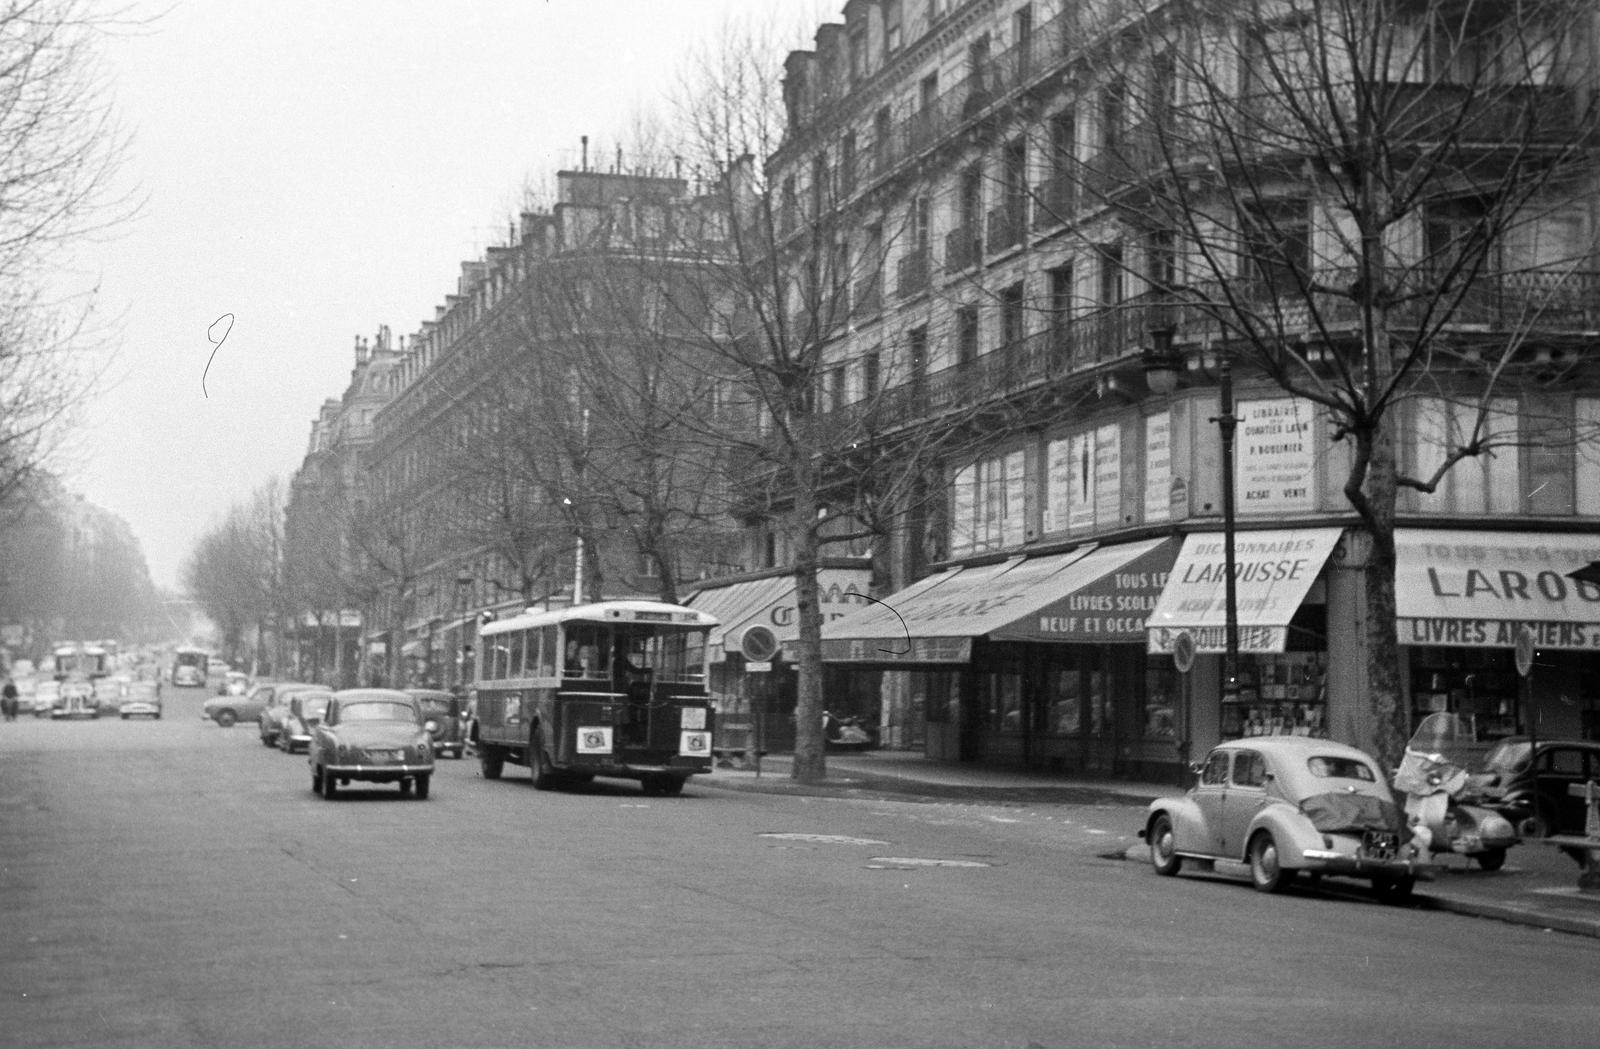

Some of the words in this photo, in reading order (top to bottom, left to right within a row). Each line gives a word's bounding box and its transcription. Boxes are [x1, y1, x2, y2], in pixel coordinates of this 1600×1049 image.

[1253, 407, 1299, 419] LIBRAIRIE
[1245, 425, 1282, 436] QUARTIER
[1285, 423, 1308, 434] LATIN
[1259, 443, 1302, 455] BOULINIER
[1246, 490, 1270, 500] ACHAT
[1283, 487, 1307, 498] VENTE
[1195, 539, 1316, 555] DICONNAIRES
[1182, 559, 1309, 584] LAROUSSE
[1115, 572, 1148, 589] TOUS
[1152, 572, 1170, 589] LE
[1070, 595, 1114, 611] LIVRES
[1040, 616, 1079, 632] NEUF
[1084, 616, 1101, 632] ET
[1412, 618, 1486, 643] LIVRES
[1190, 628, 1271, 650] BOULIER
